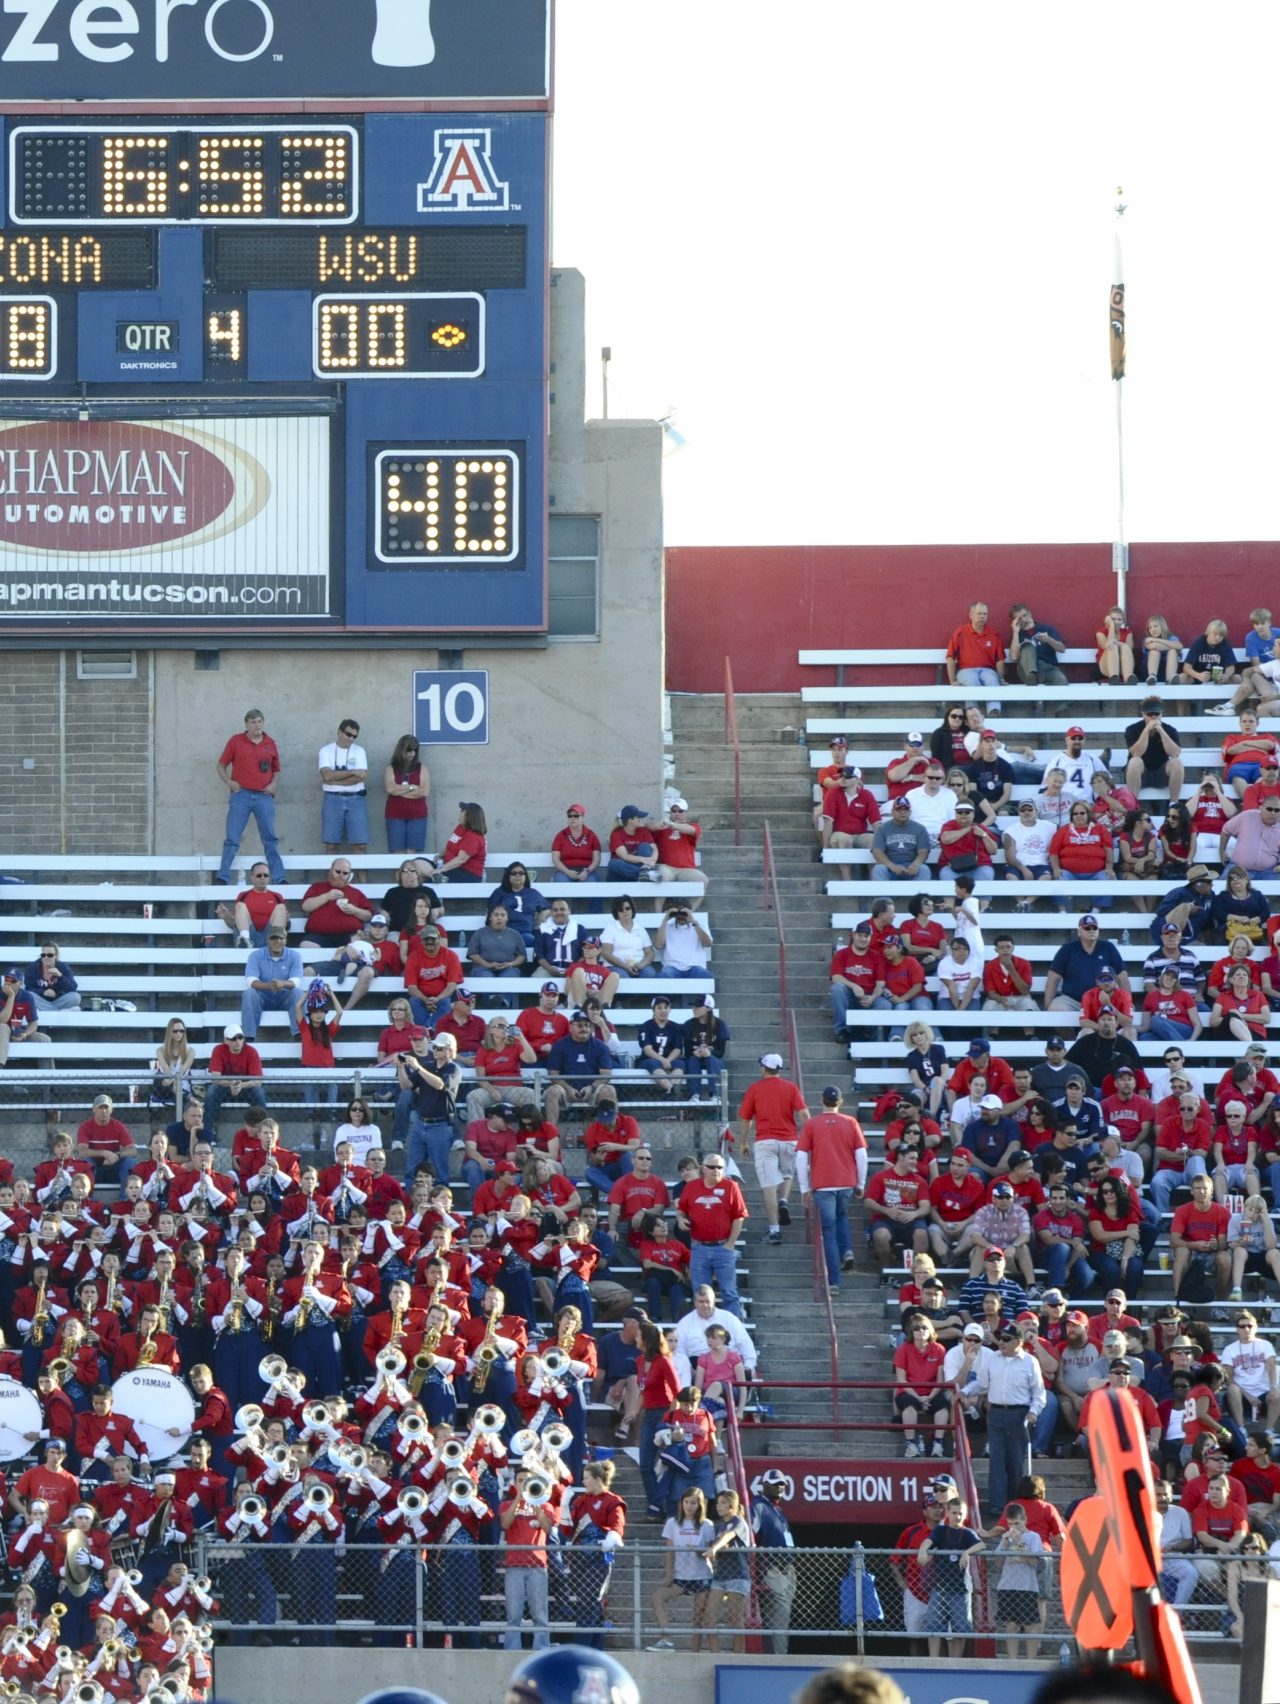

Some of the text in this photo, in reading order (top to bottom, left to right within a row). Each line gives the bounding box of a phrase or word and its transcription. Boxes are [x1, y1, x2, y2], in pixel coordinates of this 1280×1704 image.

[1, 0, 274, 62] zero
[103, 138, 345, 213] 6:52
[318, 235, 417, 281] WSU
[125, 325, 171, 350] QTR
[209, 310, 240, 361] 4
[120, 362, 177, 370] DAKTRONICS
[387, 460, 507, 552] 40
[416, 682, 485, 733] 10
[1070, 768, 1084, 789] 4
[142, 1378, 171, 1390] YAMAHA
[803, 1475, 892, 1502] SECTION
[900, 1476, 918, 1502] 11
